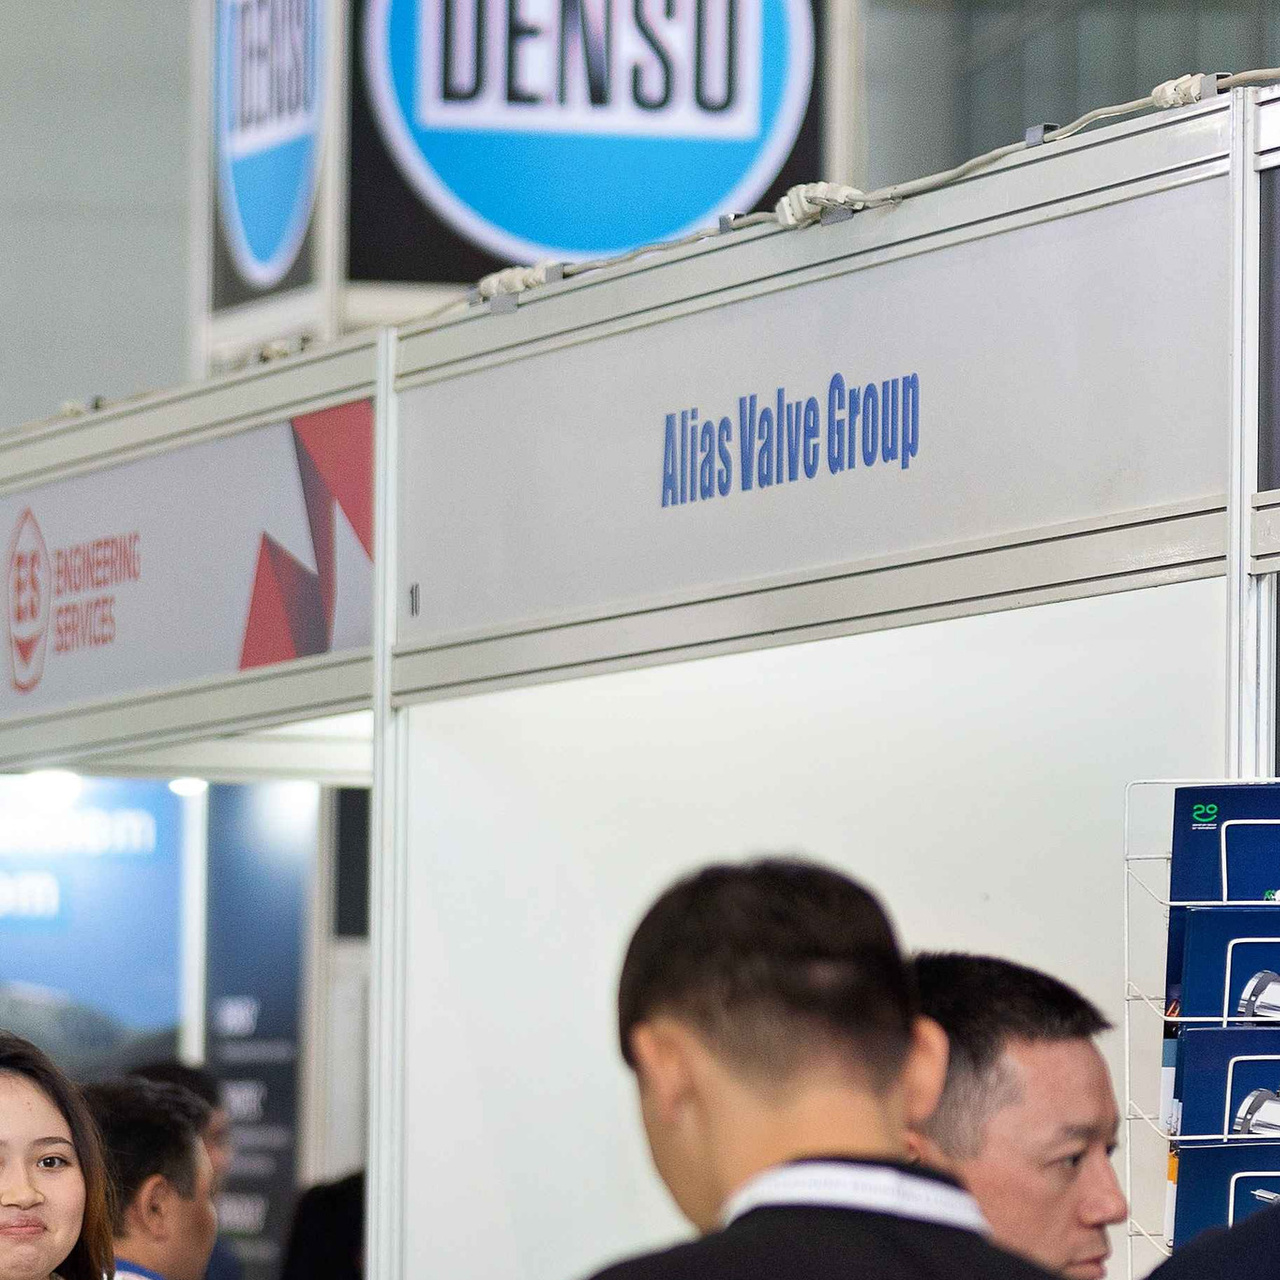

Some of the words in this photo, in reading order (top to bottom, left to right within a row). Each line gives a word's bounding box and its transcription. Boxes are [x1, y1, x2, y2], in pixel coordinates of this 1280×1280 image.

[441, 0, 735, 114] DENSO
[661, 407, 733, 508] Alias
[739, 387, 820, 492] Valve
[827, 372, 920, 475] Group
[55, 530, 140, 597] ENGINEERING
[55, 596, 116, 656] SERVICES
